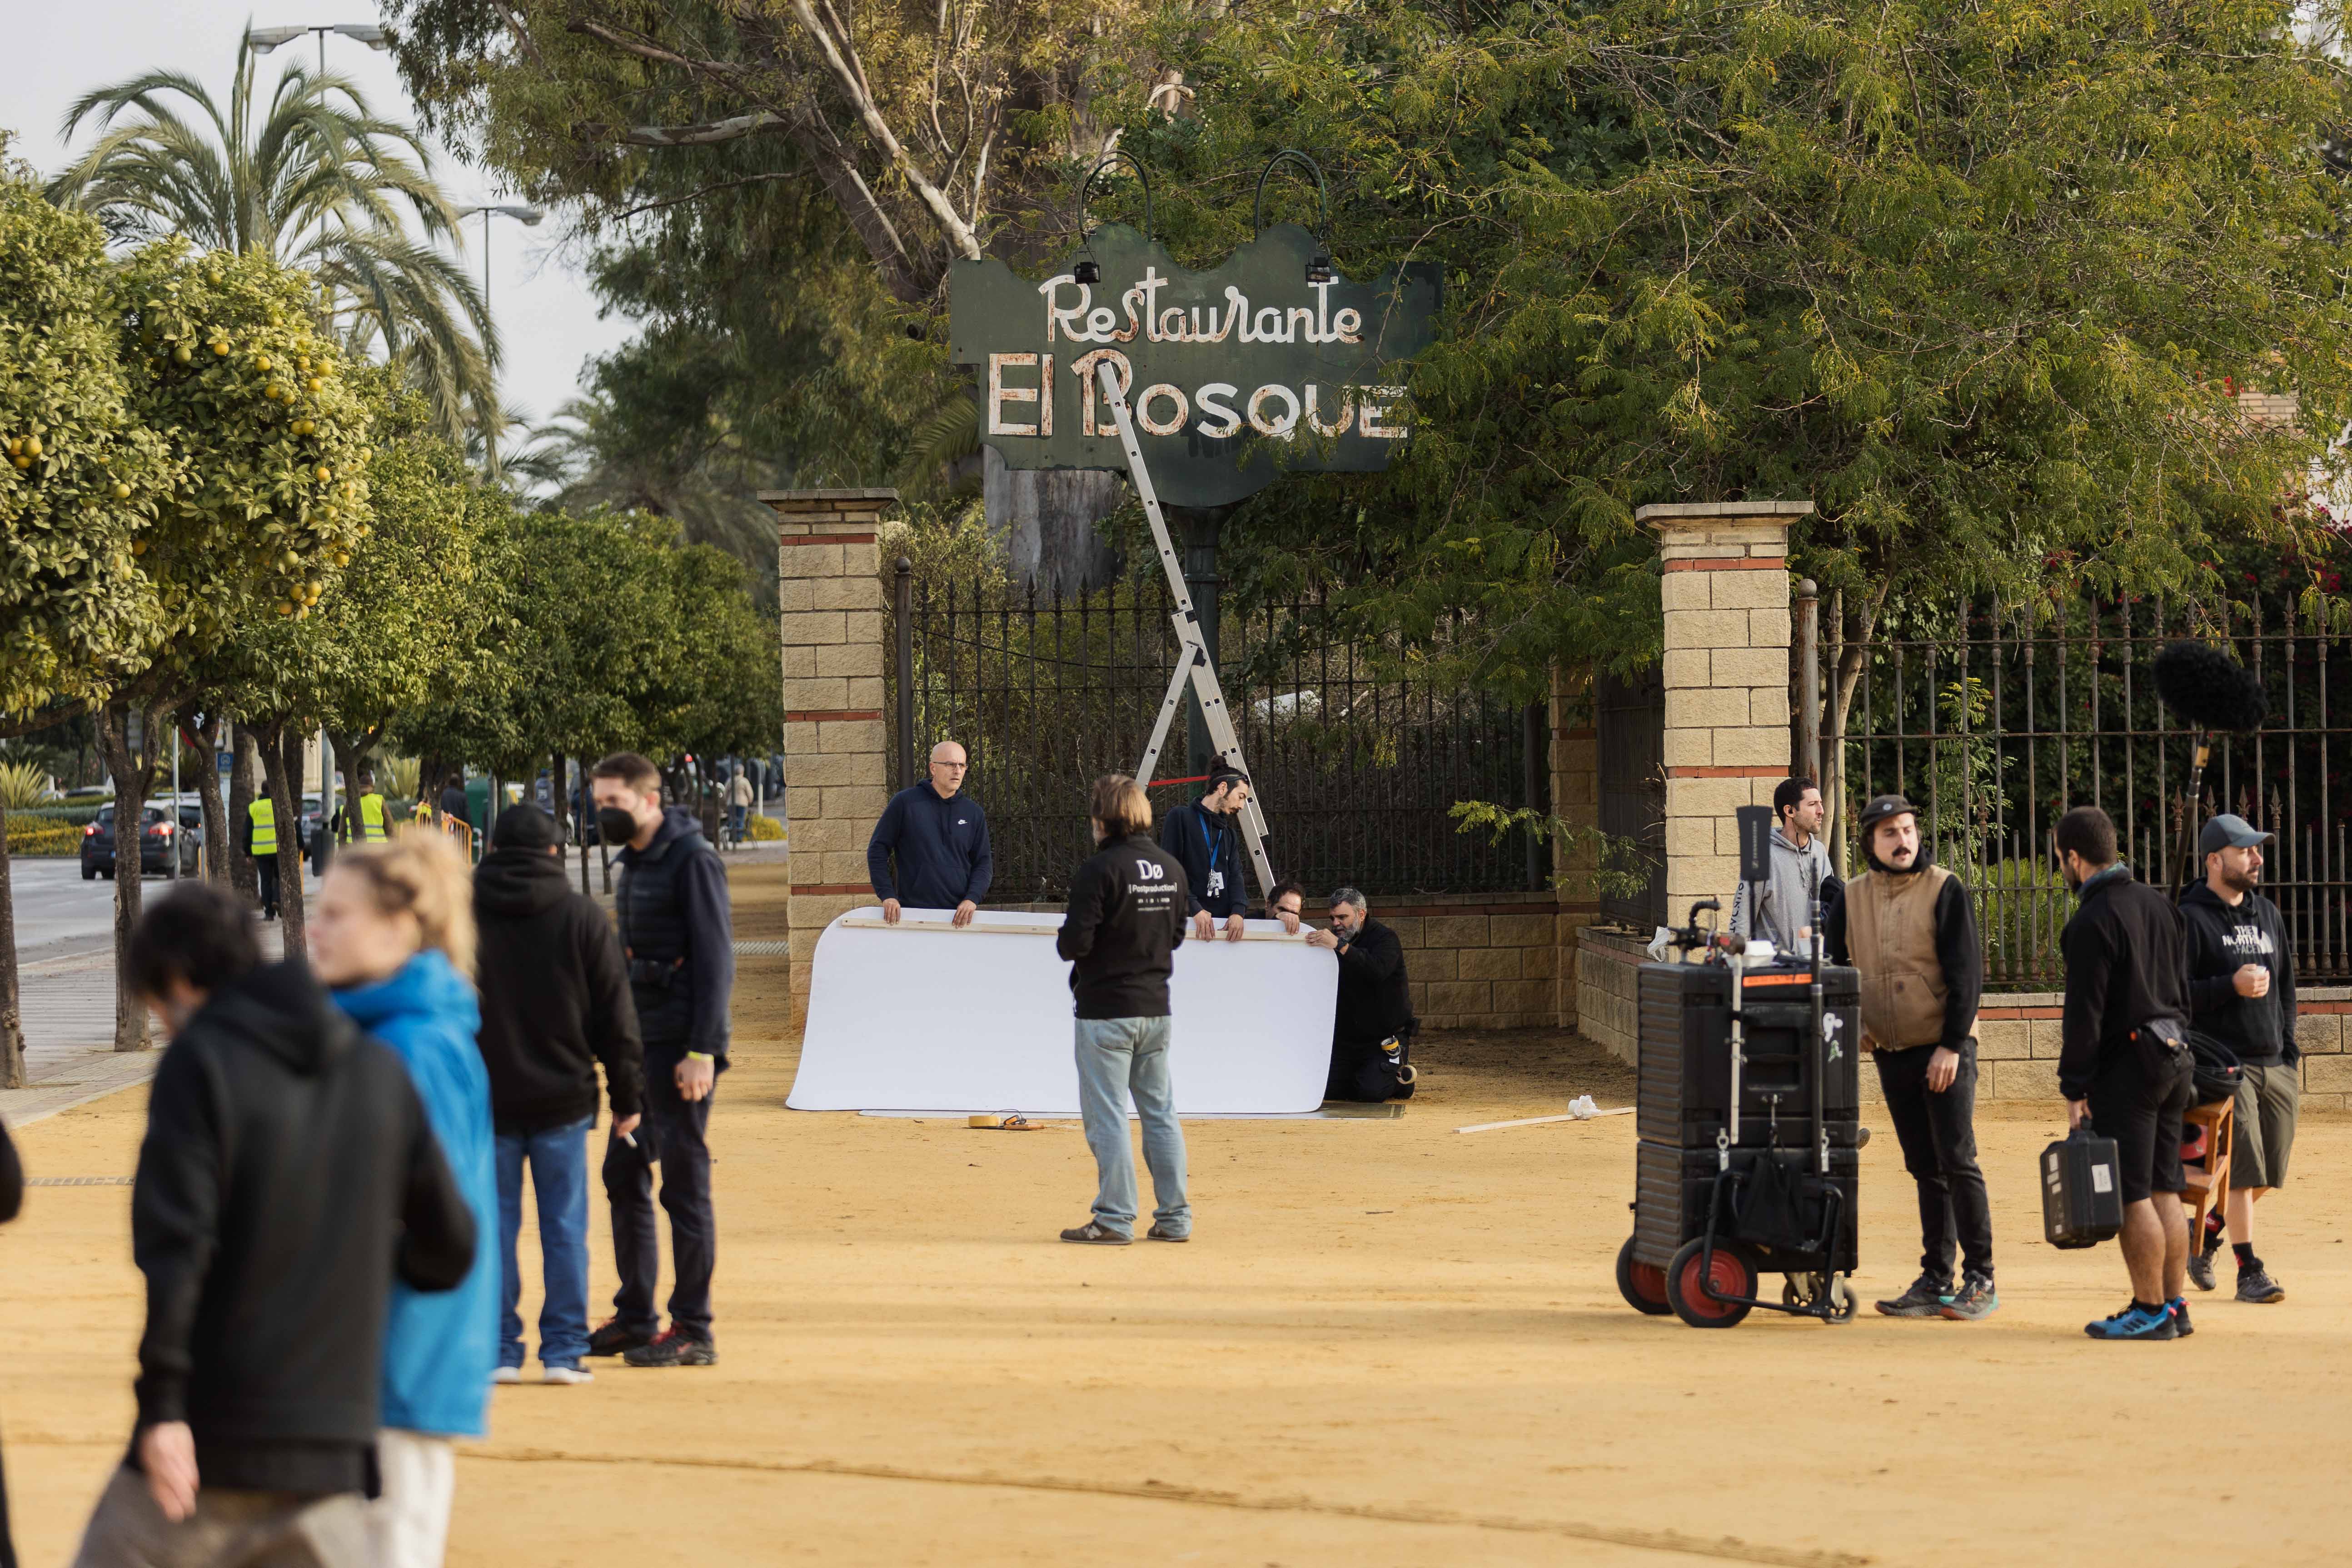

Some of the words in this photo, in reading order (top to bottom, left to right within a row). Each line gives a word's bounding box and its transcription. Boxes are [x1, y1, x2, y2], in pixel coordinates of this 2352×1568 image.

[1038, 267, 1364, 344] Restaurante
[1071, 348, 1408, 441] BOSQUE
[2222, 934, 2255, 946] NORTH
[2234, 925, 2253, 936] THE
